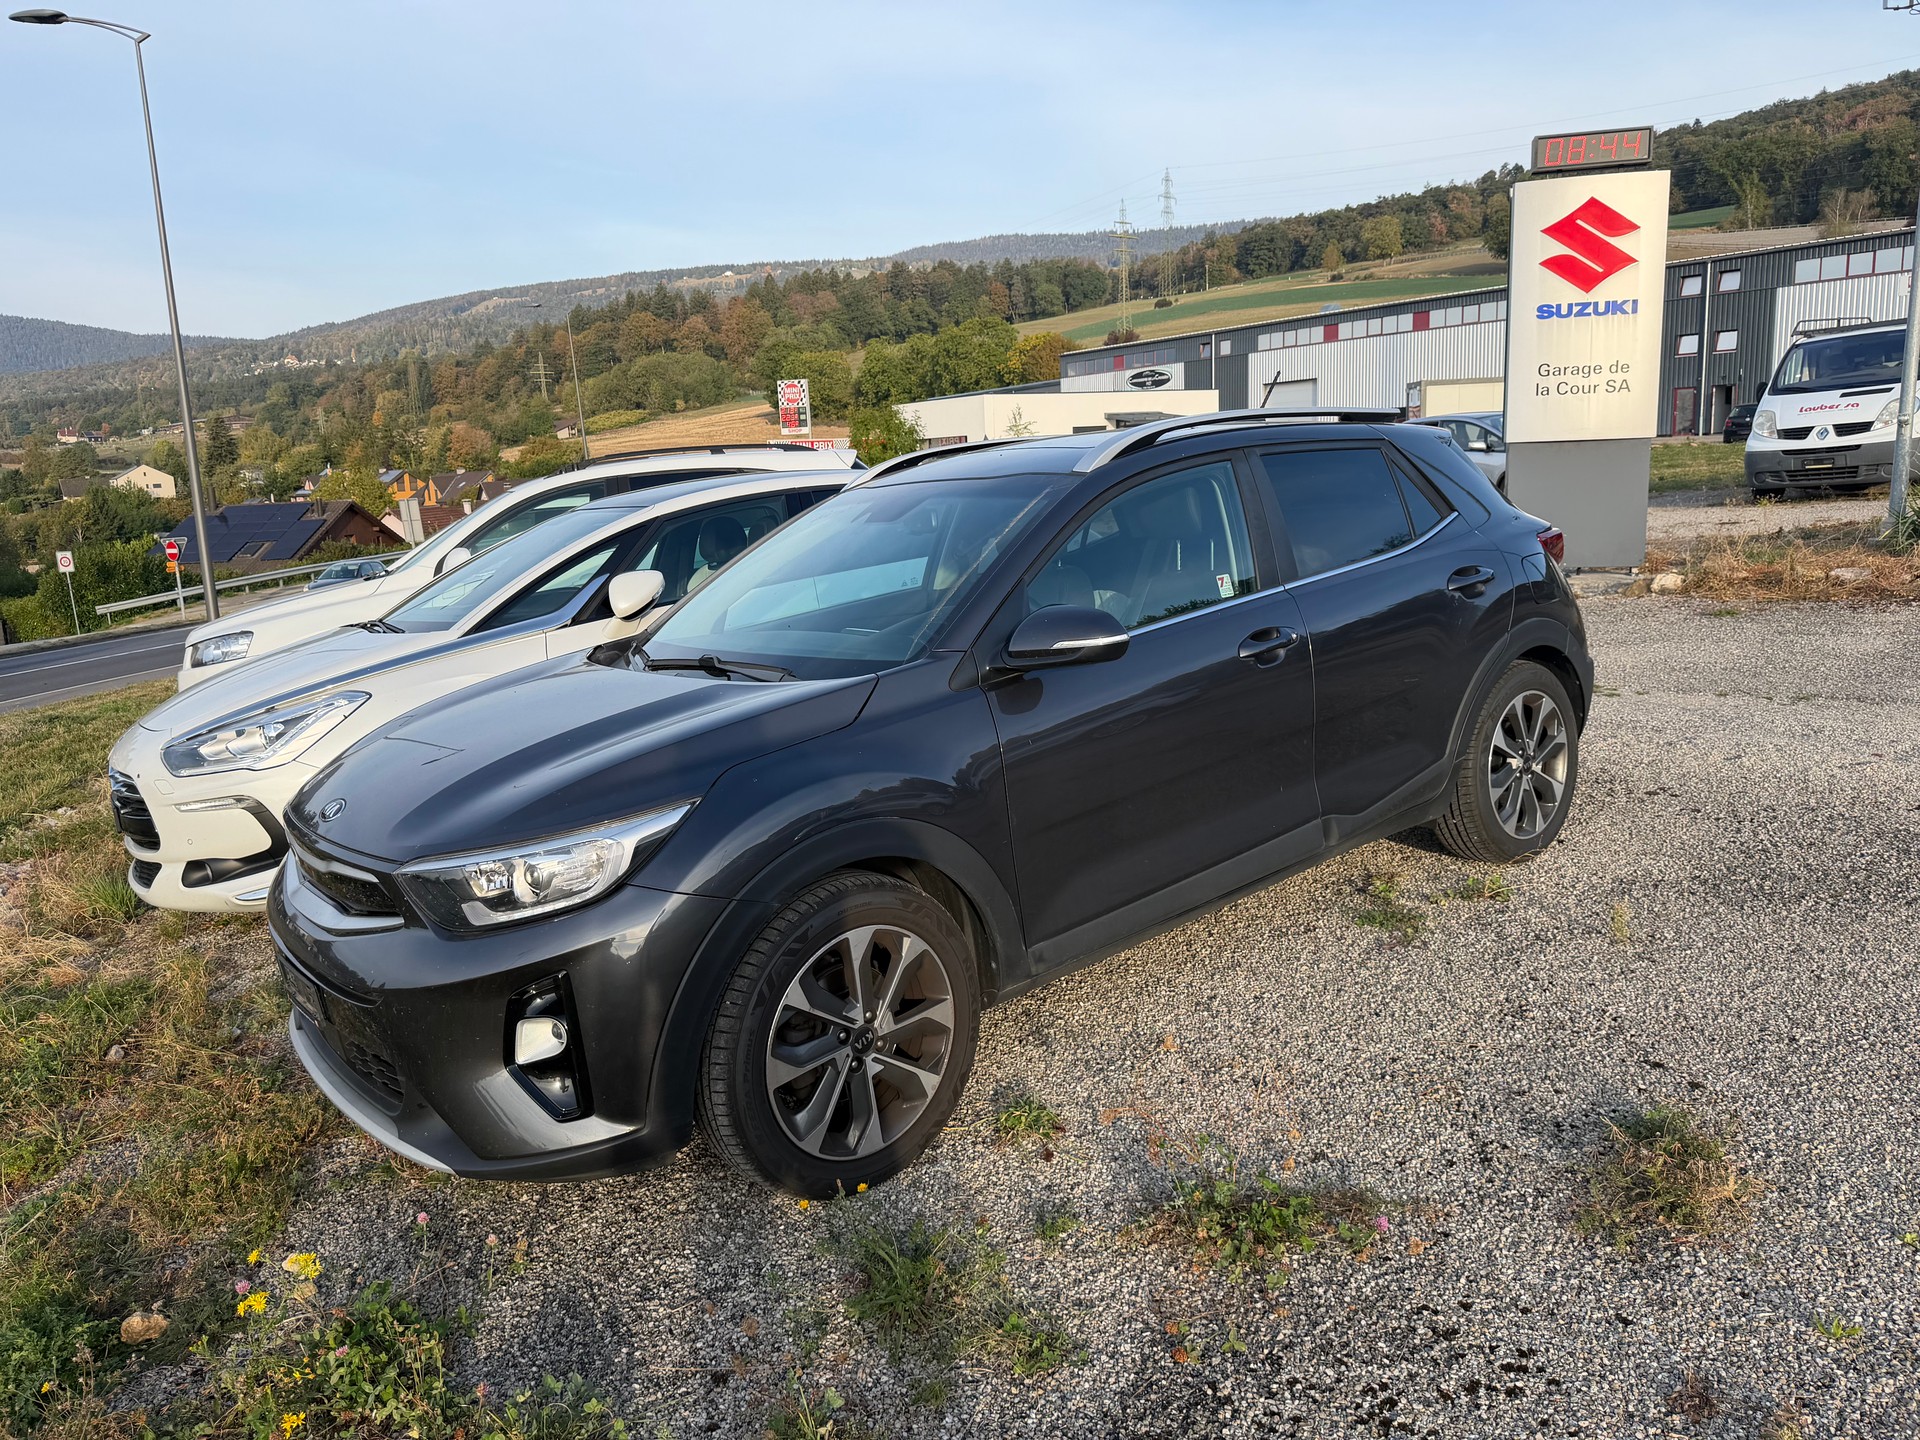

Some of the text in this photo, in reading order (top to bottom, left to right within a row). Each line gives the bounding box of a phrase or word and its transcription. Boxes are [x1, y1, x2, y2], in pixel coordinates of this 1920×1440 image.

[1544, 132, 1641, 166] 08:44
[1535, 299, 1639, 320] SUZUKI
[1537, 360, 1631, 379] Garage de
[1535, 379, 1631, 396] la Cour SA
[814, 441, 833, 450] PRIX
[854, 1030, 874, 1050] KIA
